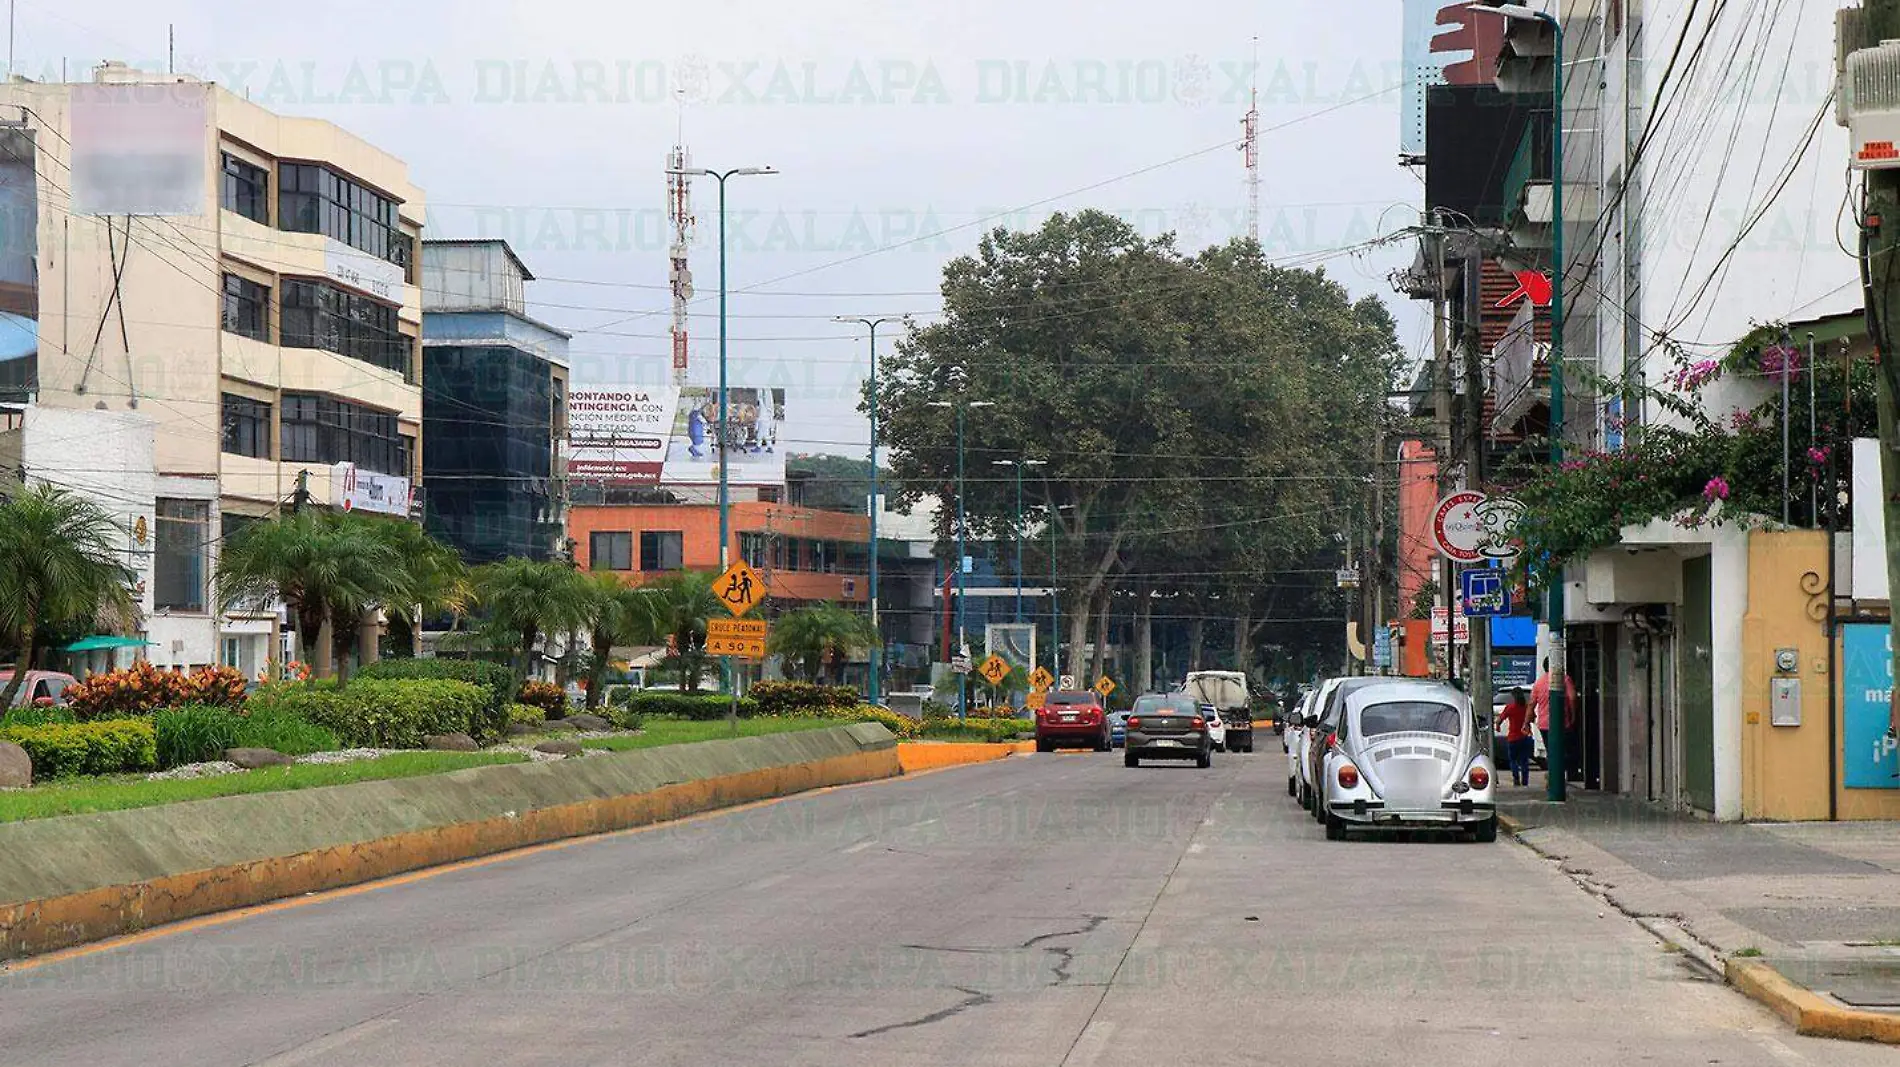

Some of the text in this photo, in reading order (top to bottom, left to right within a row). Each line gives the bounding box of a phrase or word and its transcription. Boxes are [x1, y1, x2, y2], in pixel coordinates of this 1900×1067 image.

[635, 393, 650, 402] LA
[641, 404, 663, 412] CON
[646, 414, 659, 422] EN
[714, 641, 722, 650] A
[728, 642, 744, 652] 50
